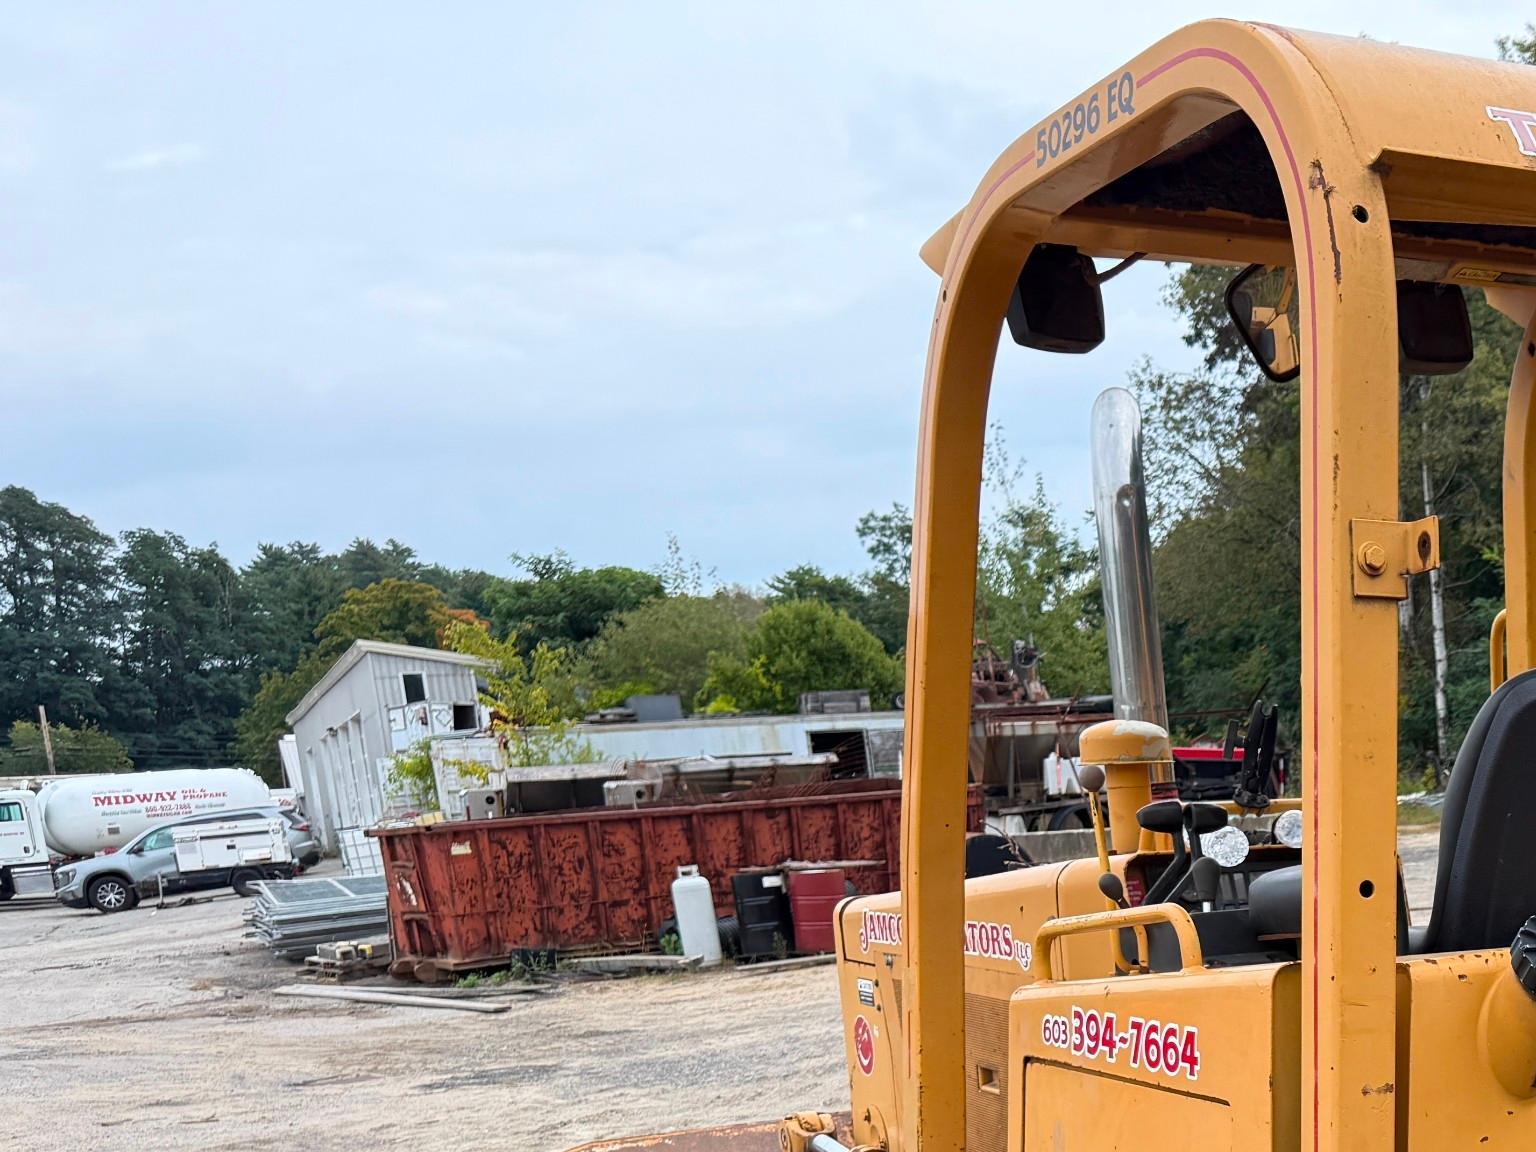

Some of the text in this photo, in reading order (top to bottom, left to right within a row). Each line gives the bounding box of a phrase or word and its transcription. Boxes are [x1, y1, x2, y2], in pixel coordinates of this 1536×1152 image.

[1036, 71, 1135, 168] 50296 EQ
[93, 791, 177, 807] MIDWAY
[1043, 1015, 1069, 1046] 603
